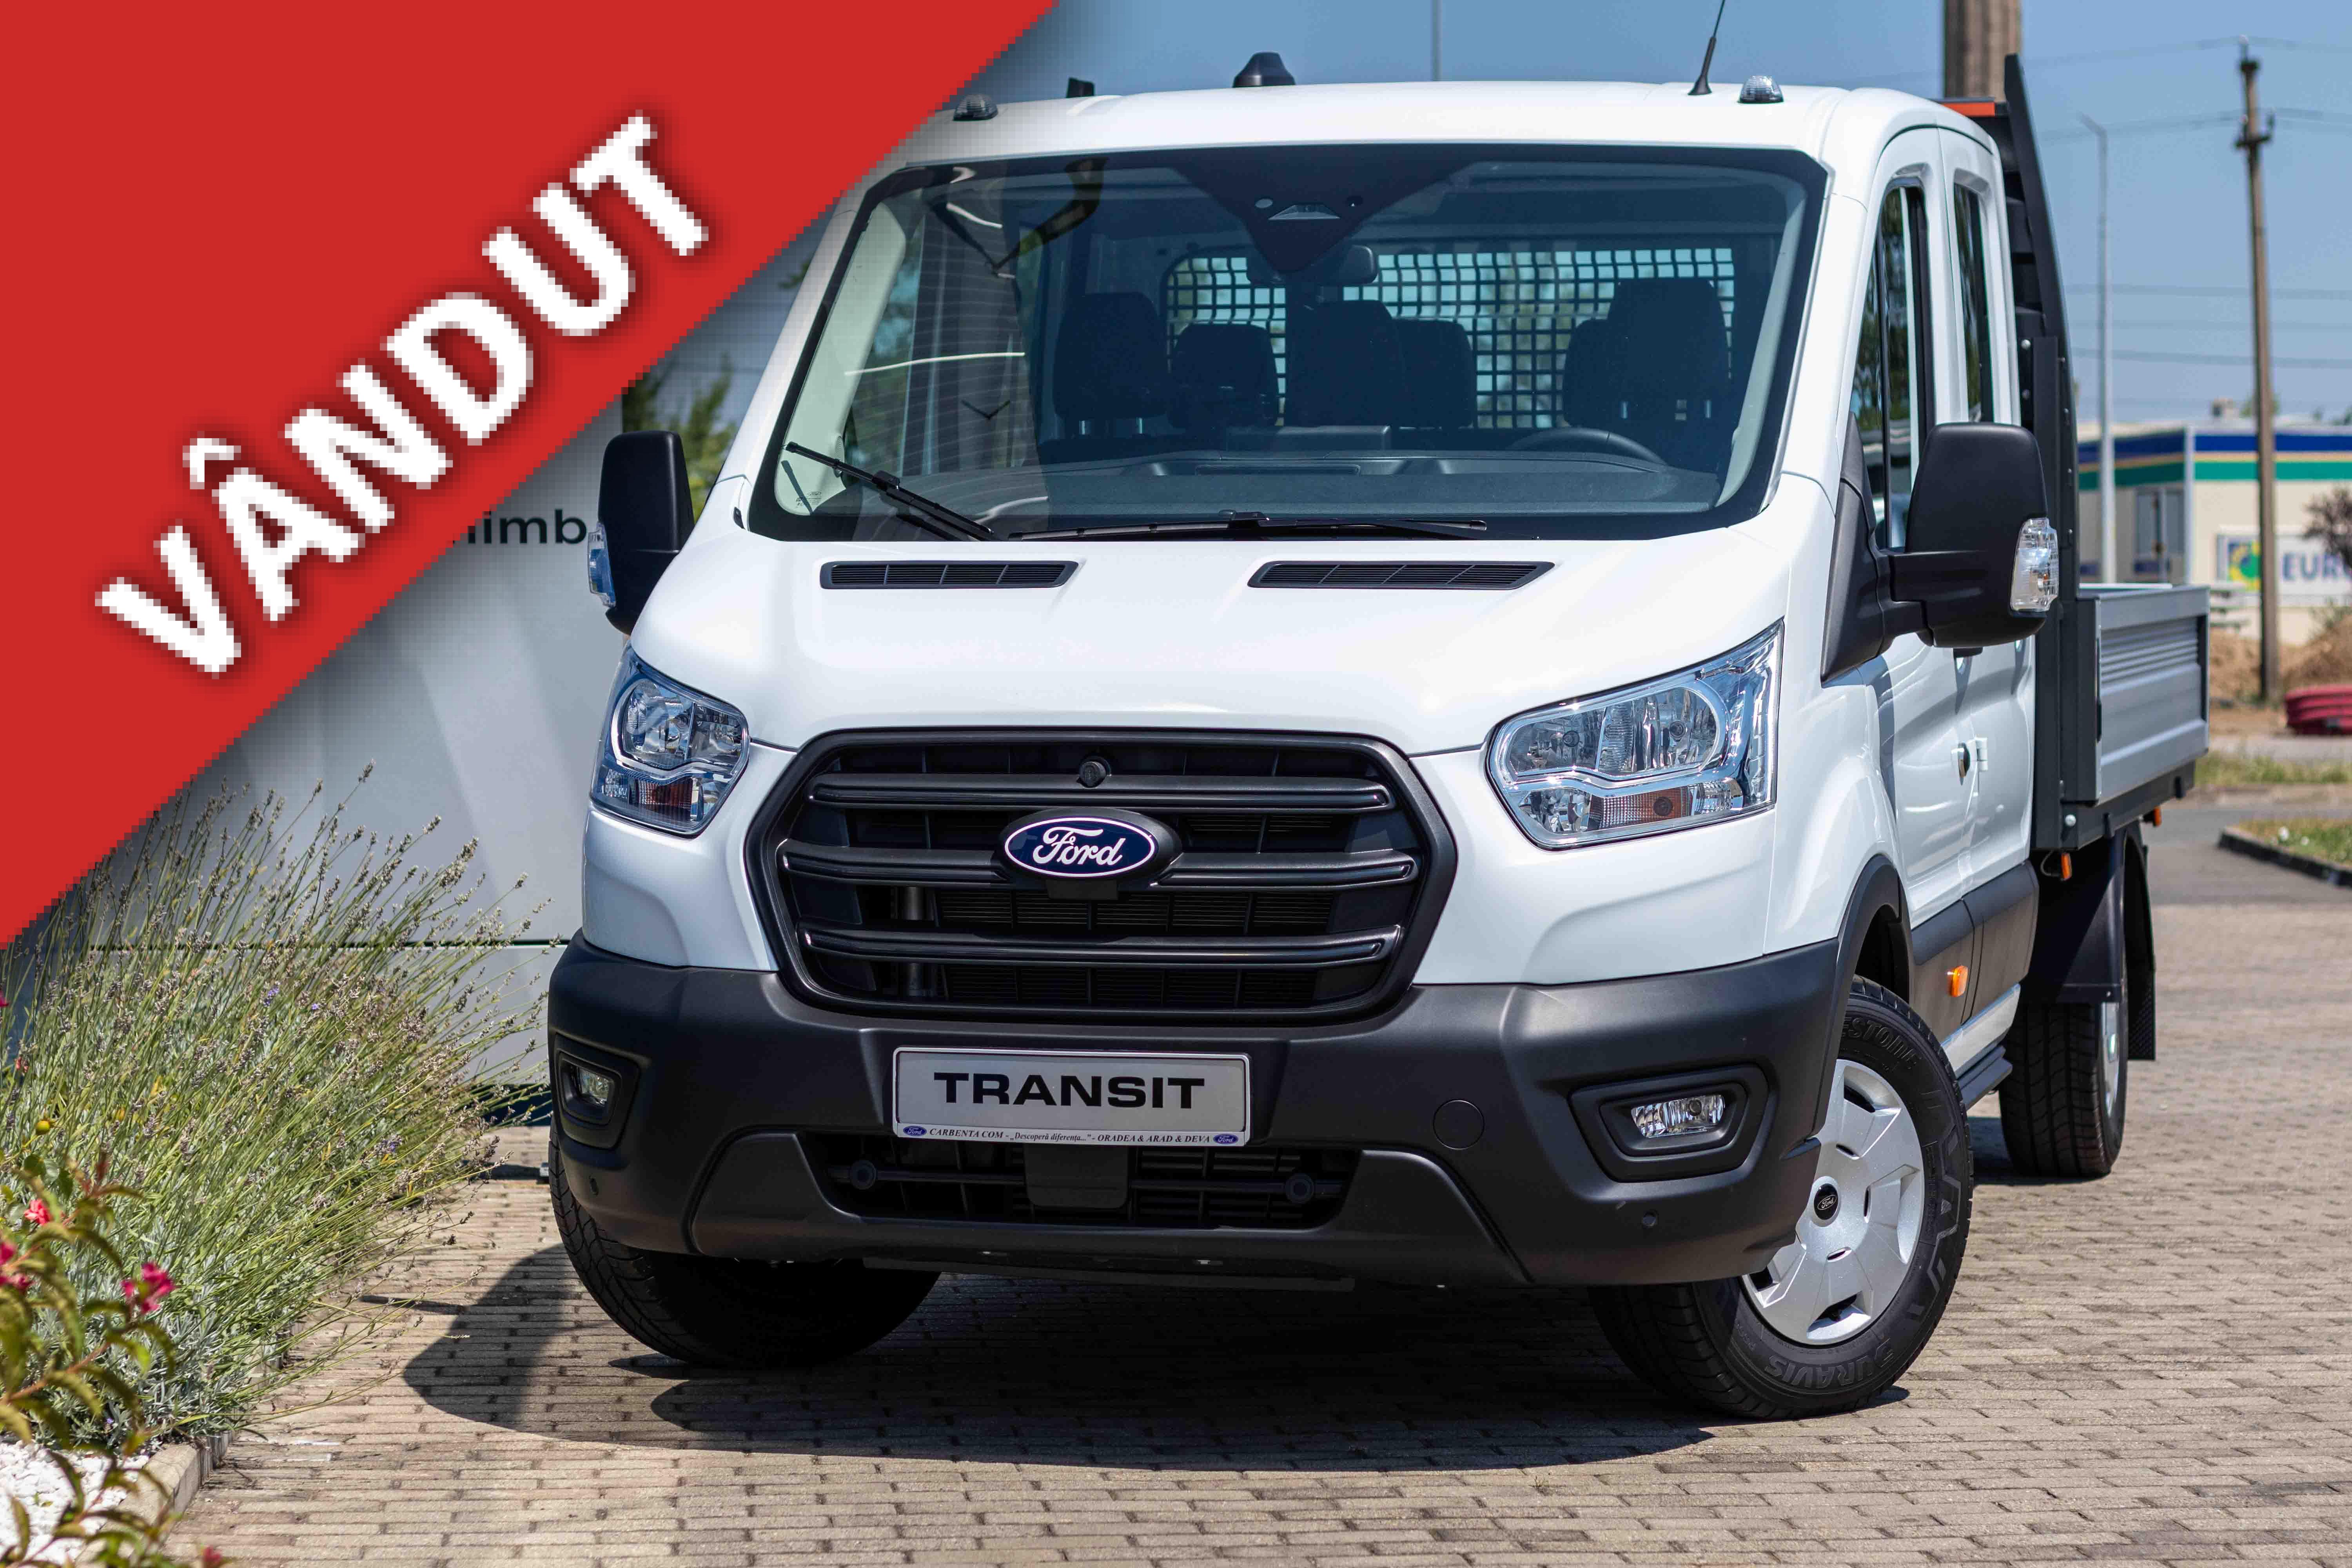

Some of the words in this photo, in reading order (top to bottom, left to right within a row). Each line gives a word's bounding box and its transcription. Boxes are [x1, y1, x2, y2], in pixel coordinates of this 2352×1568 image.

[1033, 827, 1126, 865] Ford
[934, 1072, 1205, 1109] TRANSIT
[929, 1128, 979, 1137] CARBENTA
[1821, 1198, 1834, 1209] Ford
[1765, 1338, 1894, 1388] DURAVIS
